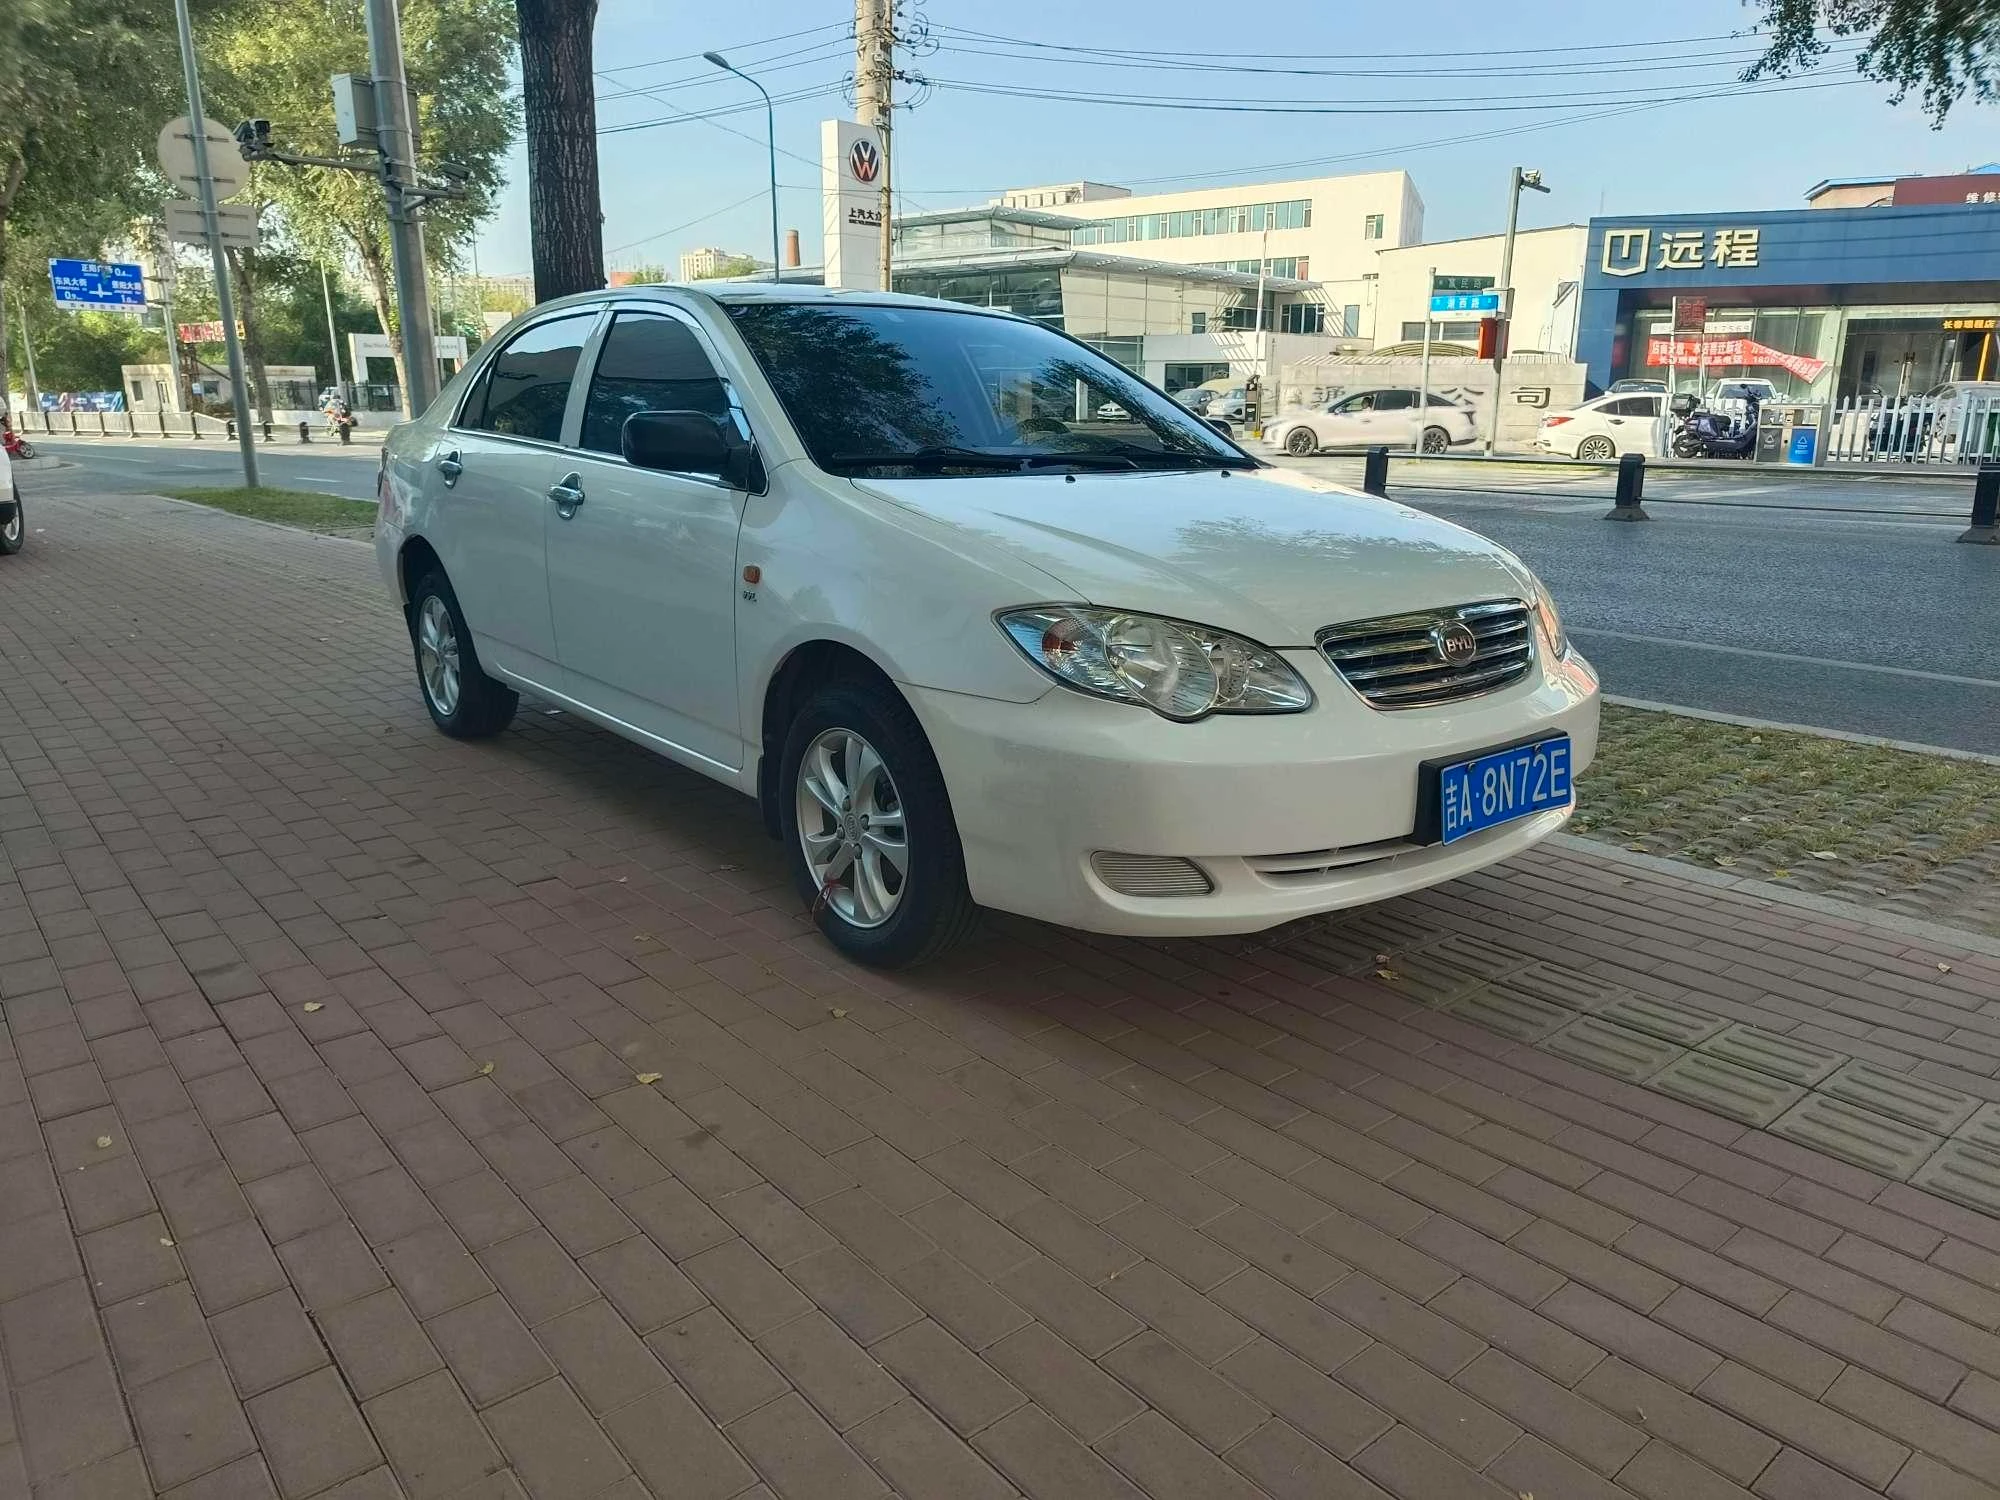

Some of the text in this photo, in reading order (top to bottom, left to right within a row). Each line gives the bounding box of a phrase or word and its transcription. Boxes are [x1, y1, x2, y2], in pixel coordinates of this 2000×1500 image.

[1965, 191, 2000, 204] 维修
[1655, 229, 1760, 270] 远程
[1445, 635, 1473, 653] BYD
